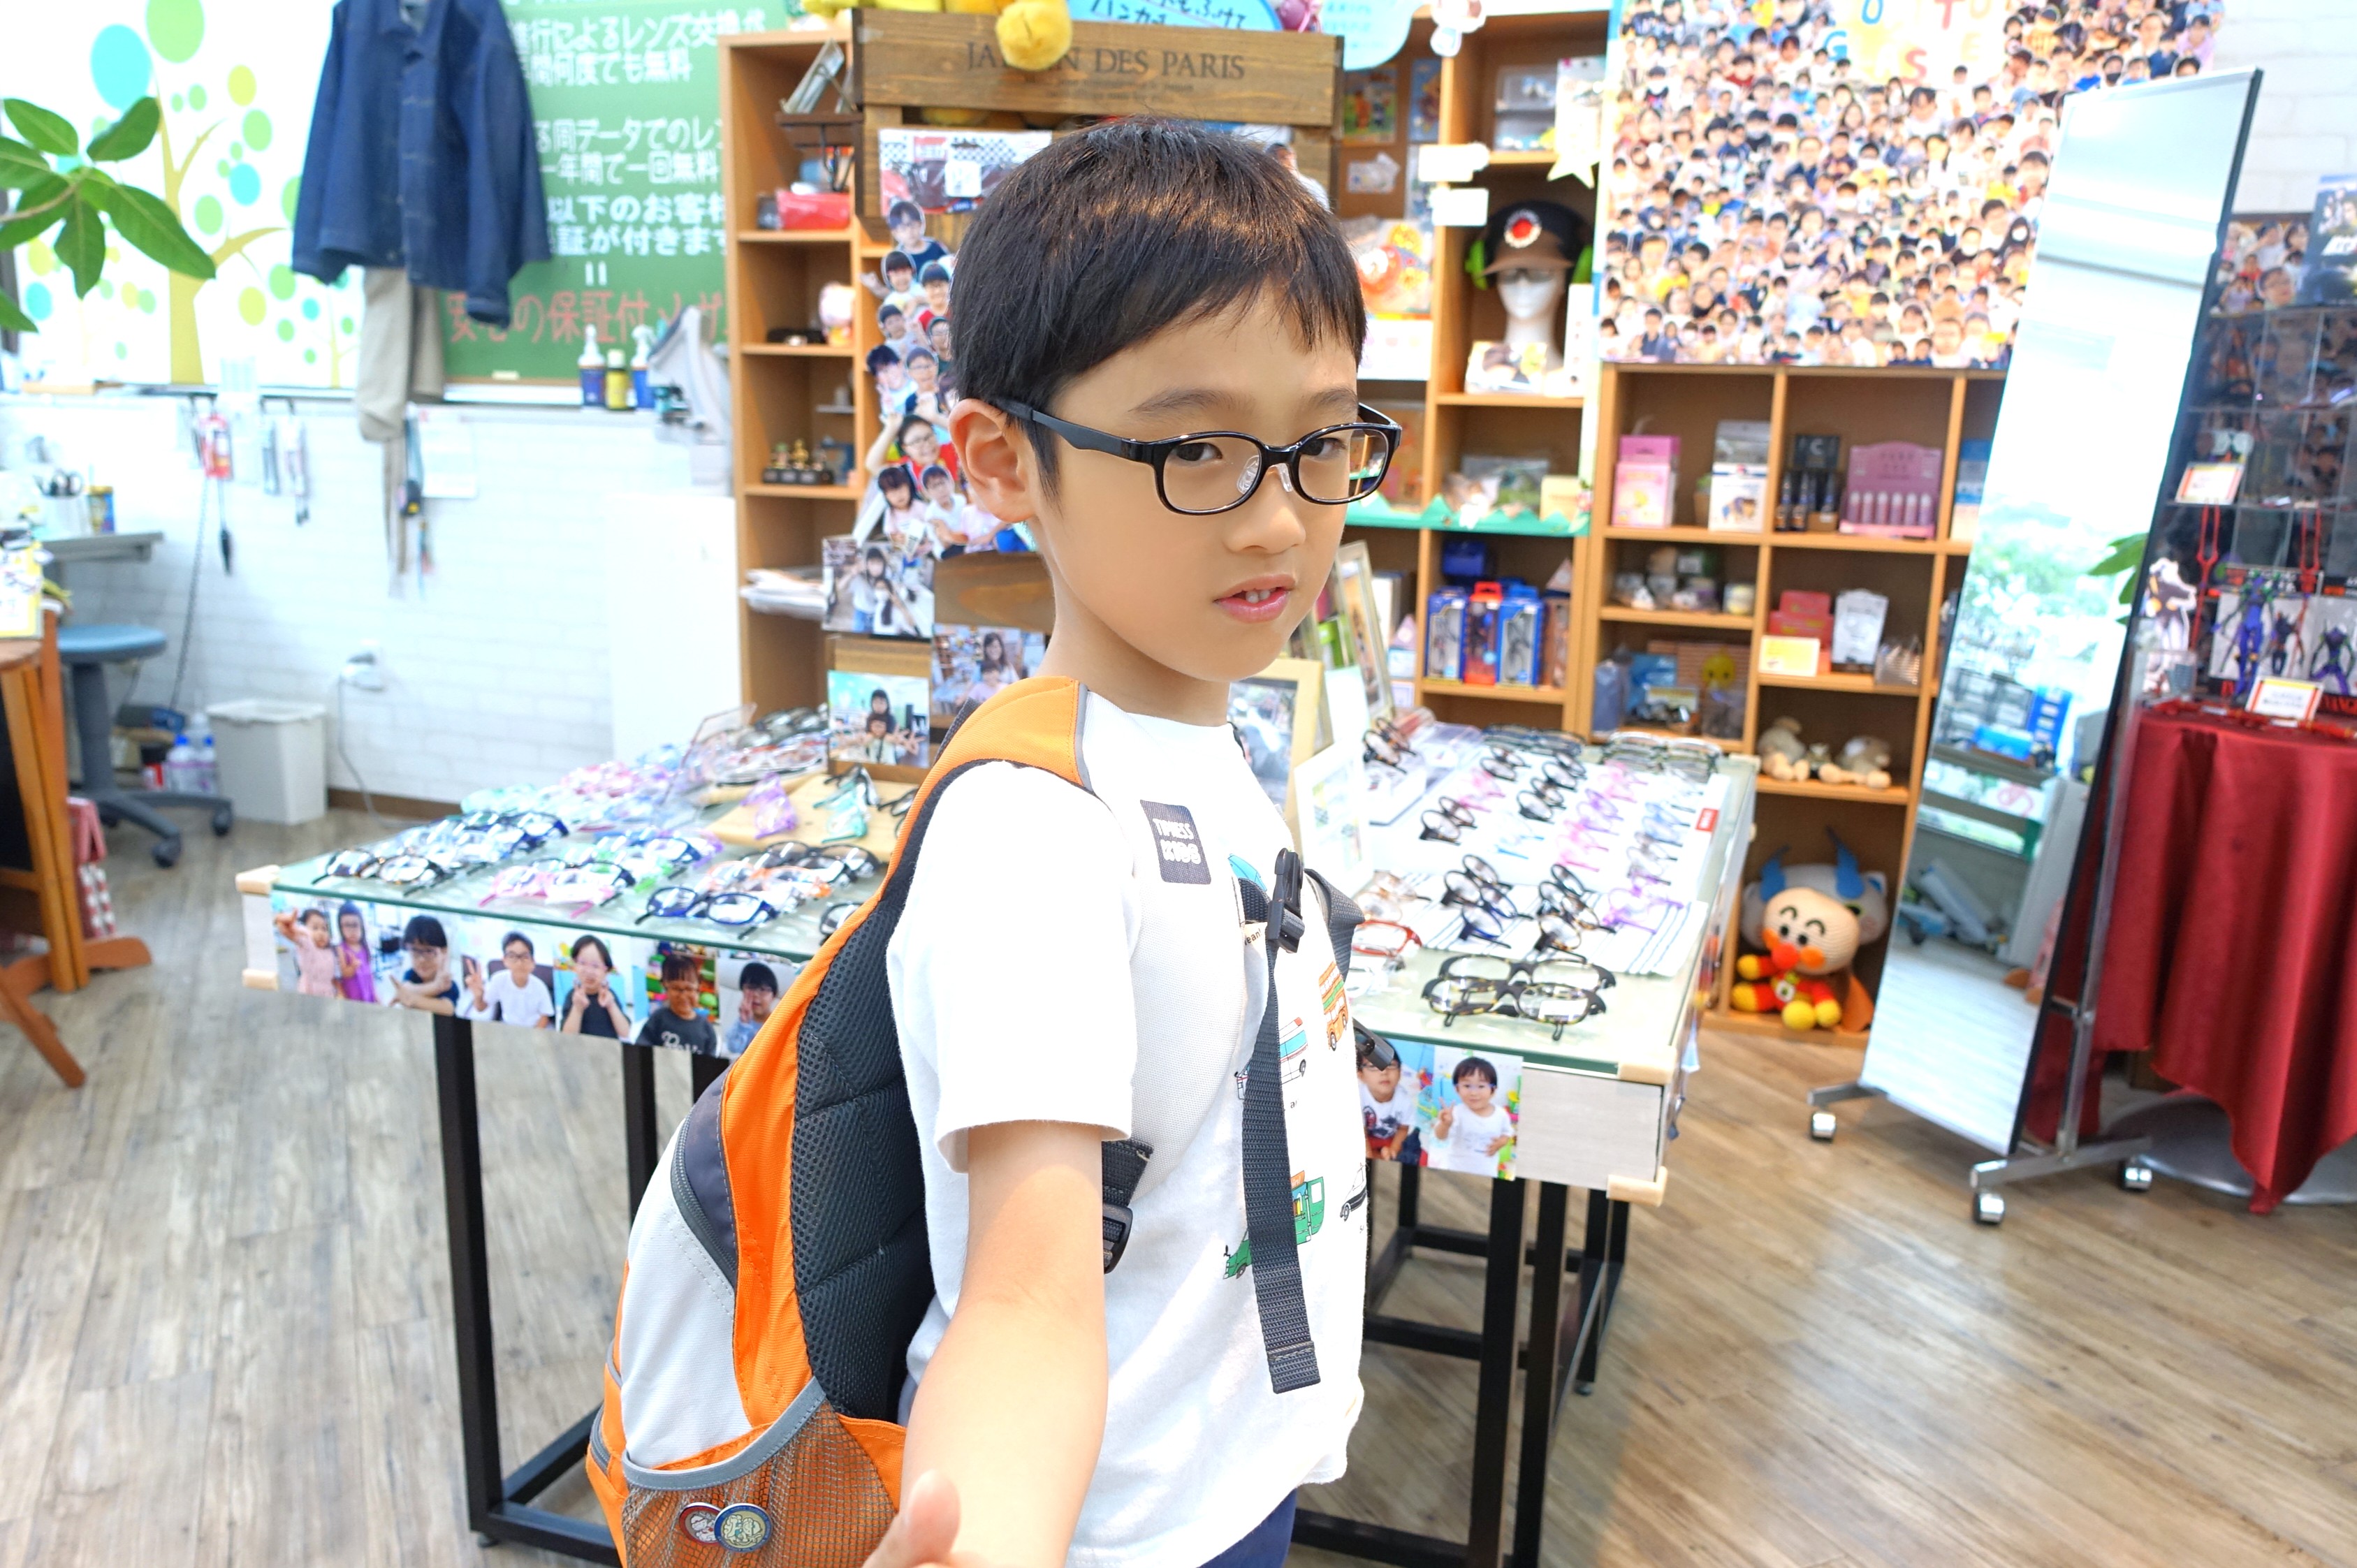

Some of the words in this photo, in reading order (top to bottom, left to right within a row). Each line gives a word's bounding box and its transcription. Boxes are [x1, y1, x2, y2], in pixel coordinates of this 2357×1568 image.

[1095, 47, 1149, 75] DES
[1162, 50, 1246, 80] PARIS
[1160, 839, 1202, 865] KIDS
